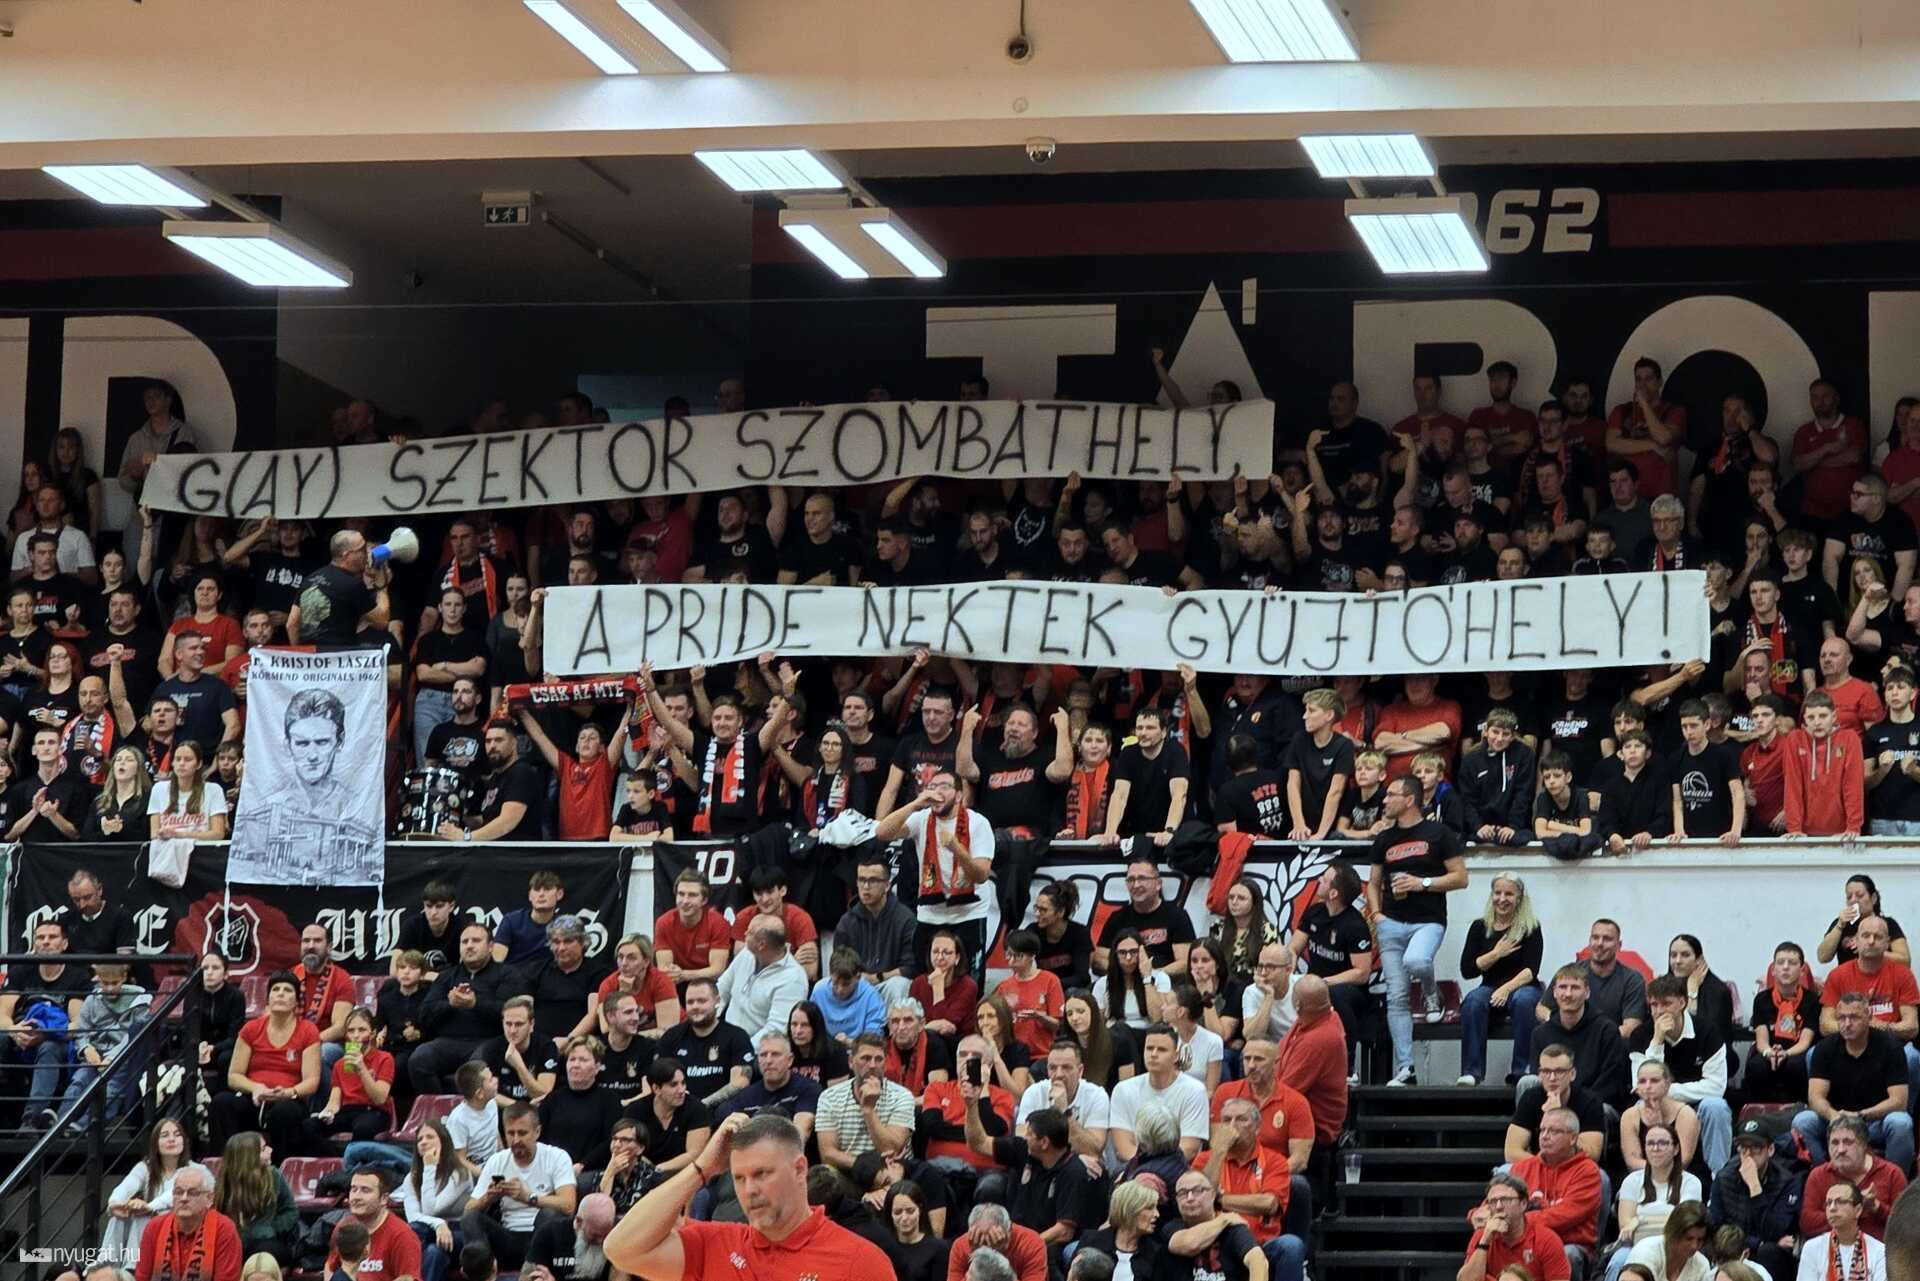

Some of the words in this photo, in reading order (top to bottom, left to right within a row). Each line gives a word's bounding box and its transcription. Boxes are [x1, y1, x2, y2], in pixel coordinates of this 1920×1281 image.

[1435, 186, 1600, 254] 62
[177, 446, 338, 519] G(AY)
[382, 419, 697, 511] SZEKTOR
[736, 402, 1240, 481] SZOMBATHELY,
[572, 588, 611, 670] A
[640, 587, 823, 664] PRIDE
[857, 586, 1124, 659] NEKTEK
[529, 685, 570, 703] CSAK
[573, 683, 592, 701] AZ
[593, 680, 624, 698] MTE
[359, 1259, 383, 1272] das
